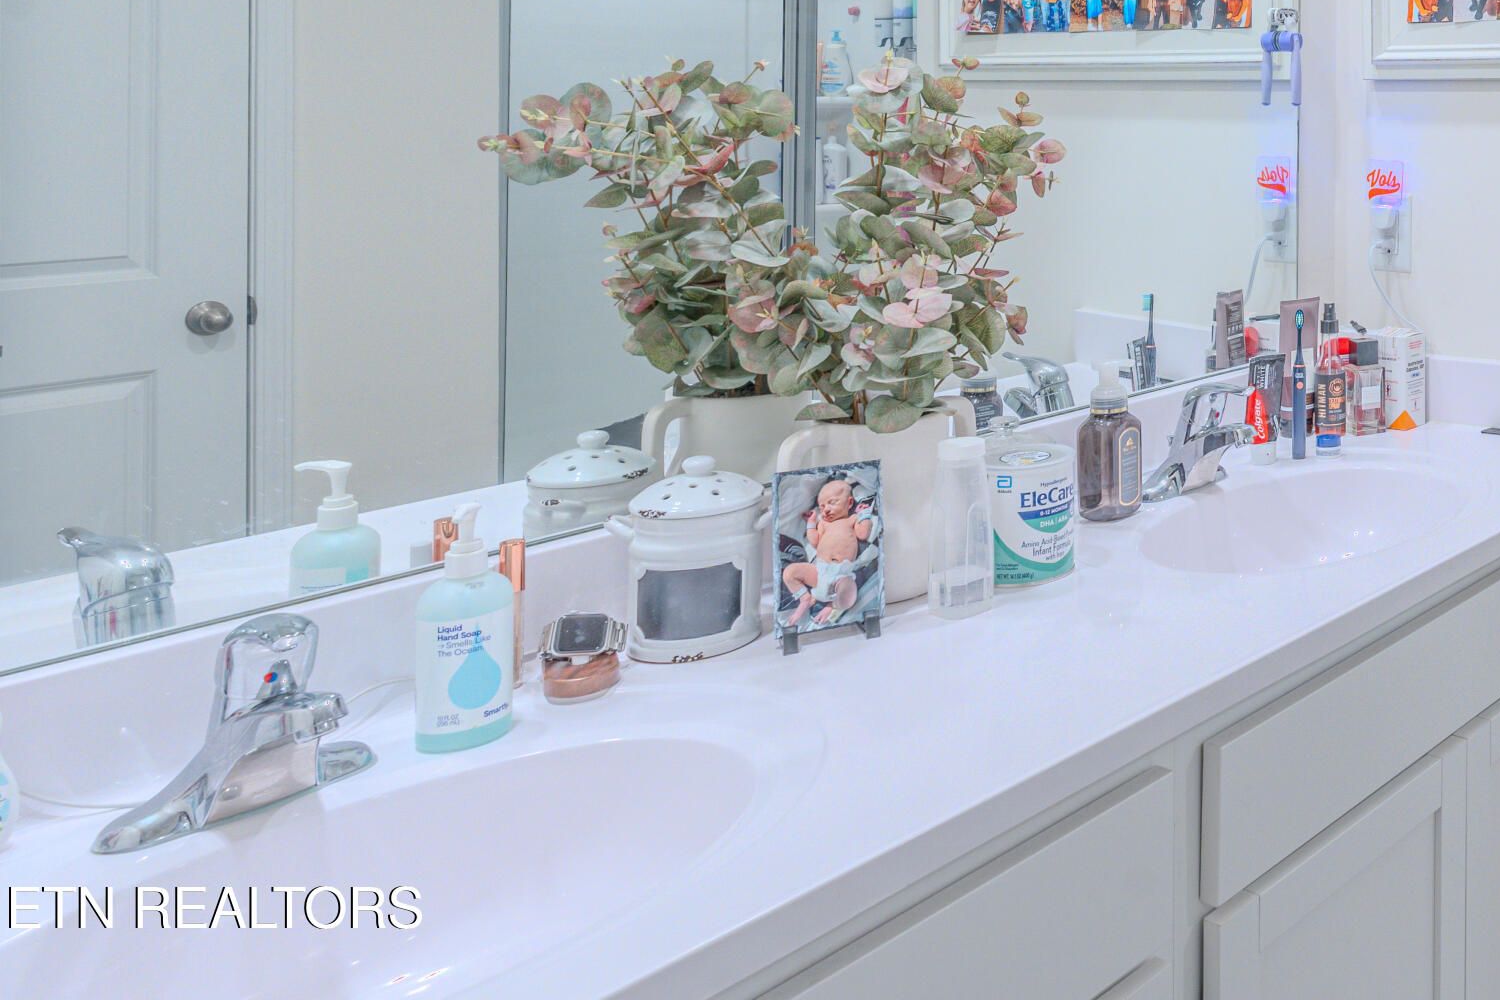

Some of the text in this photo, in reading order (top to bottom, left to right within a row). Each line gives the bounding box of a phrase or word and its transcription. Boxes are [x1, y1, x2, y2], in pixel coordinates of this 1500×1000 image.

[1367, 169, 1400, 195] Vols
[1318, 383, 1327, 418] HITMAN
[1254, 399, 1266, 439] Colgate
[1020, 483, 1074, 508] EleCare
[1039, 520, 1055, 528] DHA
[1033, 545, 1052, 557] Infant
[437, 624, 463, 634] Liquid
[460, 630, 482, 639] Soap
[446, 635, 492, 649] Smells Like
[437, 650, 452, 658] The
